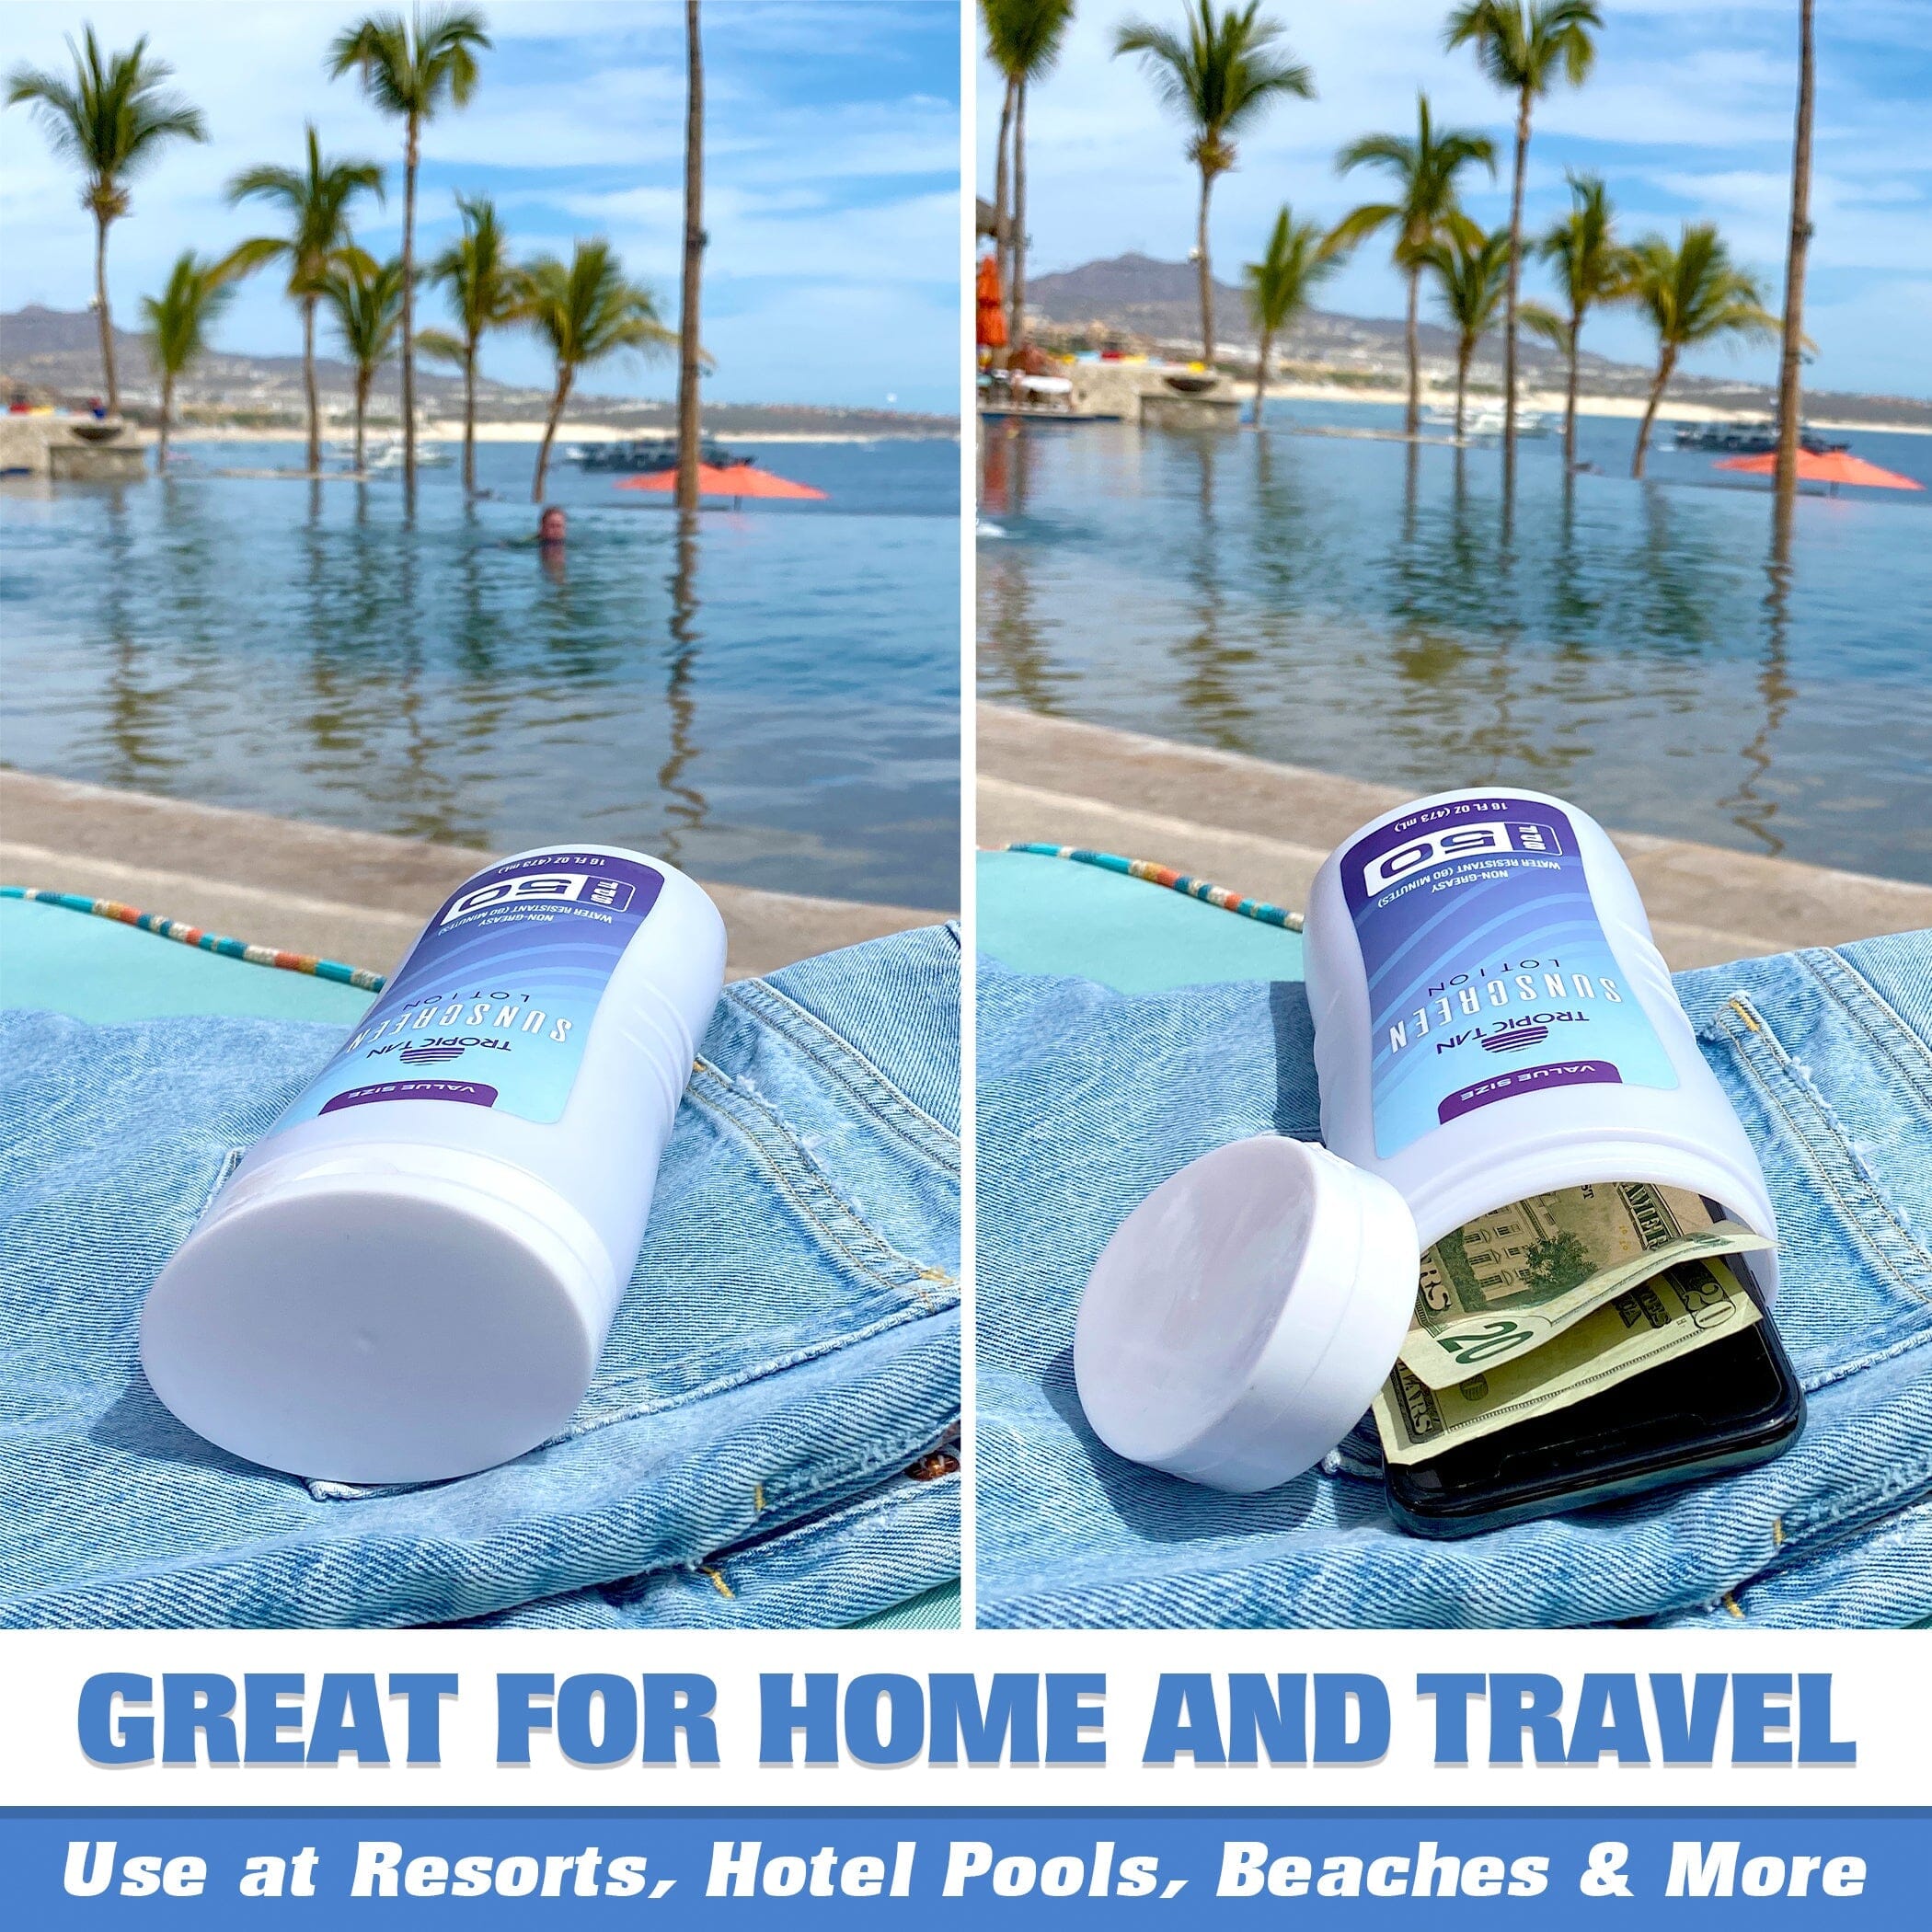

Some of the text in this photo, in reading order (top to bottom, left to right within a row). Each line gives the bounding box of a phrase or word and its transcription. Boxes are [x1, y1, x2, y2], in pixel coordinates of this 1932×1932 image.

[1421, 808, 1450, 822] (473
[1455, 805, 1468, 814] OZ
[1473, 803, 1488, 811] FL
[1395, 818, 1417, 832] mL)
[1381, 825, 1546, 879] SPF 50
[523, 857, 552, 868] (473
[556, 857, 569, 865] OZ
[574, 857, 587, 866] FL
[1457, 859, 1518, 873] RESISTANT
[1522, 859, 1561, 869] WATER
[1432, 869, 1508, 892] NON-GREASY
[458, 880, 618, 912] SPF 50
[1378, 875, 1430, 908] MINUTES)
[513, 904, 571, 914] RESISTANT
[573, 908, 613, 924] WATER
[478, 914, 555, 926] NON-GREASY
[1428, 959, 1559, 996] LOTION
[403, 992, 530, 1010] LOTION
[1388, 972, 1623, 1053] SUNSCREEN
[346, 1003, 572, 1052] SUNSCREEN
[1436, 1011, 1589, 1054] TROPIC TAN
[367, 1037, 512, 1058] TROPIC TAN
[348, 1084, 476, 1098] VALUE SIZE
[1461, 1064, 1595, 1101] VALUE SIZE
[1685, 1282, 1737, 1330] 20
[1436, 1321, 1535, 1364] 20
